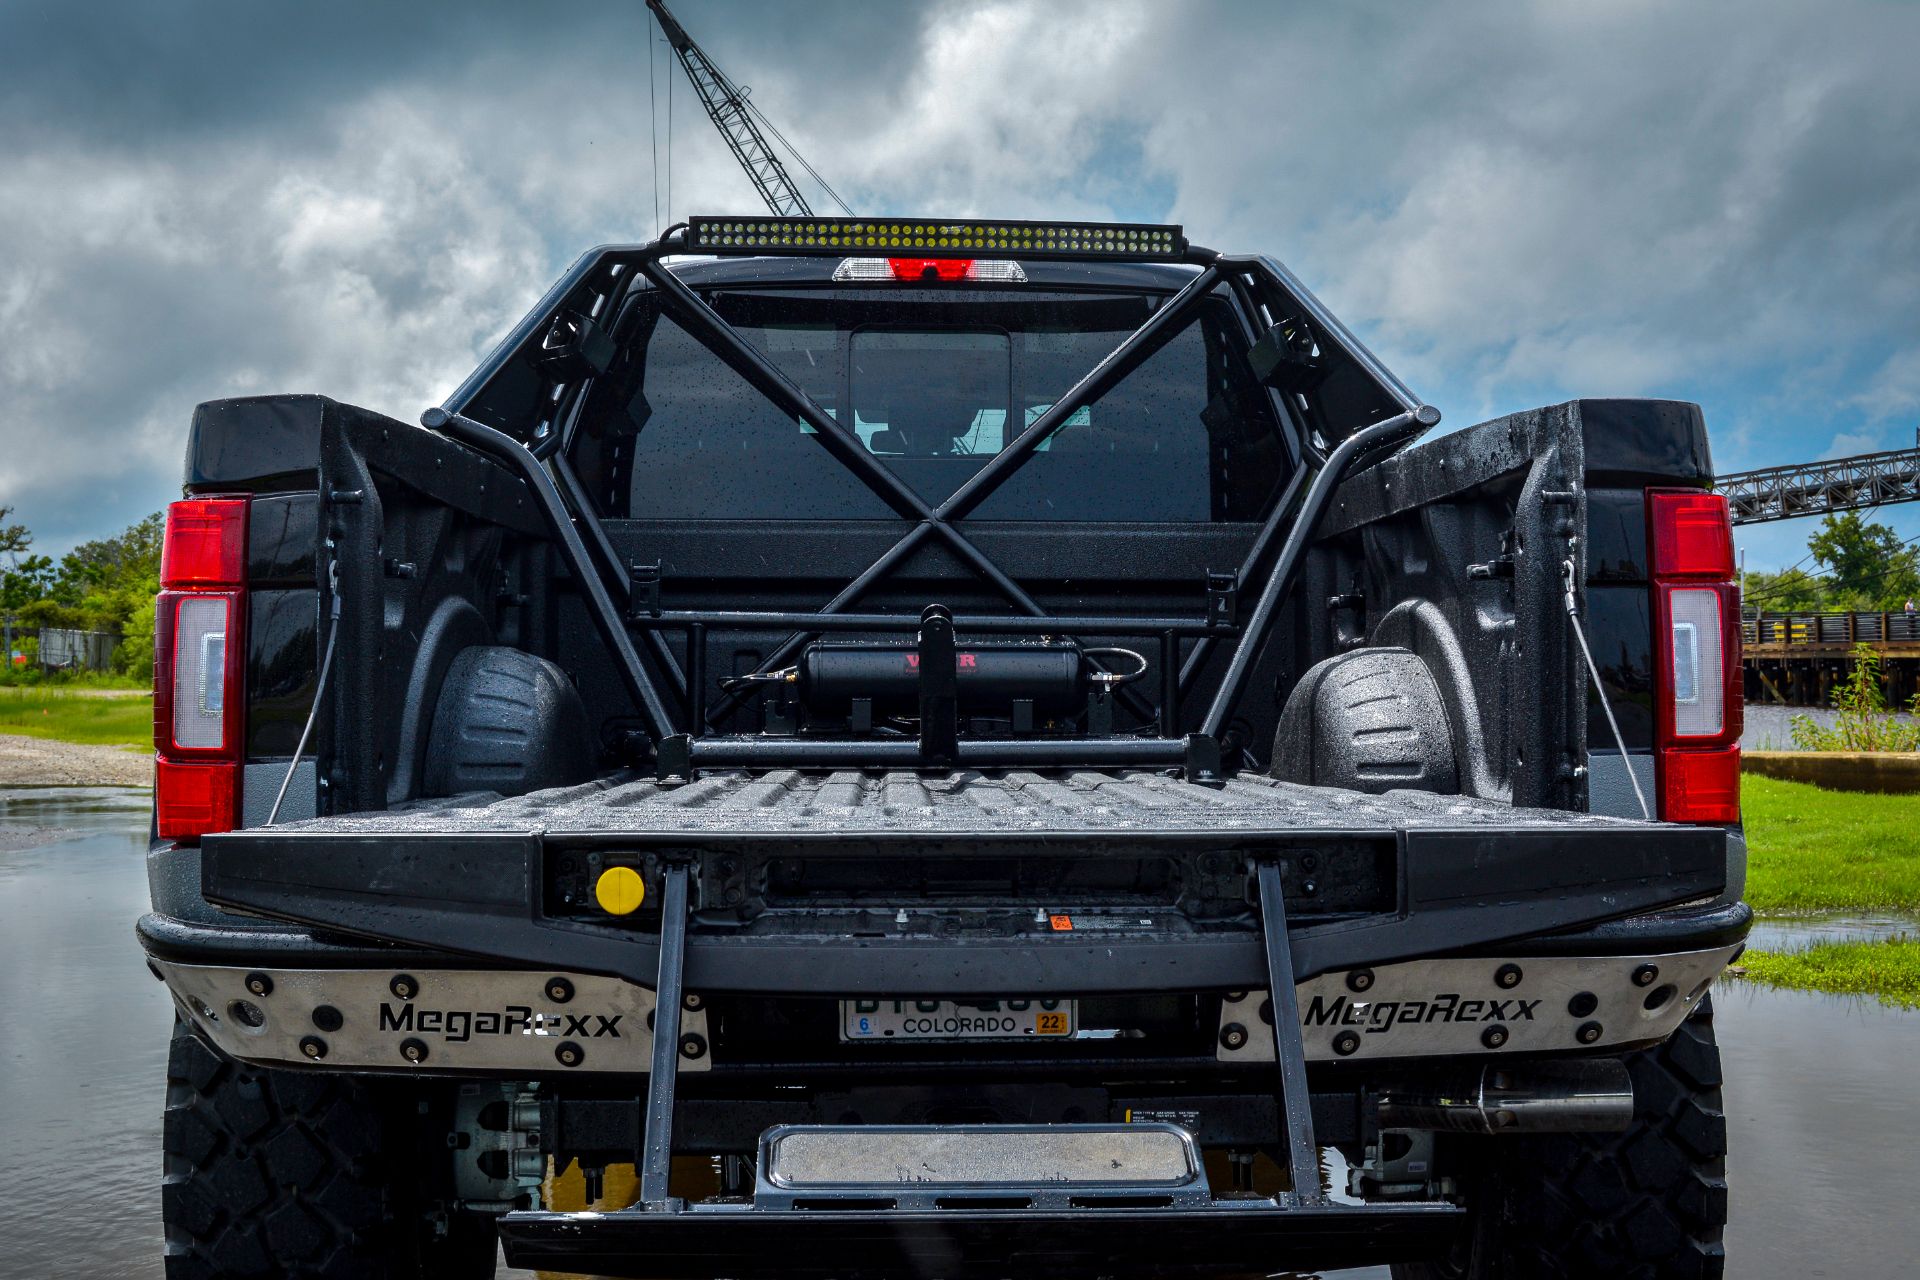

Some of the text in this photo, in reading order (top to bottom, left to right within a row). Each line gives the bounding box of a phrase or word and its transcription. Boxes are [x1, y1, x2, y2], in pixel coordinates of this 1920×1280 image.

[379, 1002, 623, 1042] MegaRexx
[1041, 1015, 1059, 1029] 22
[1303, 993, 1543, 1034] MegaRexx
[859, 1017, 869, 1031] 6
[903, 1017, 1016, 1034] COLORADO
